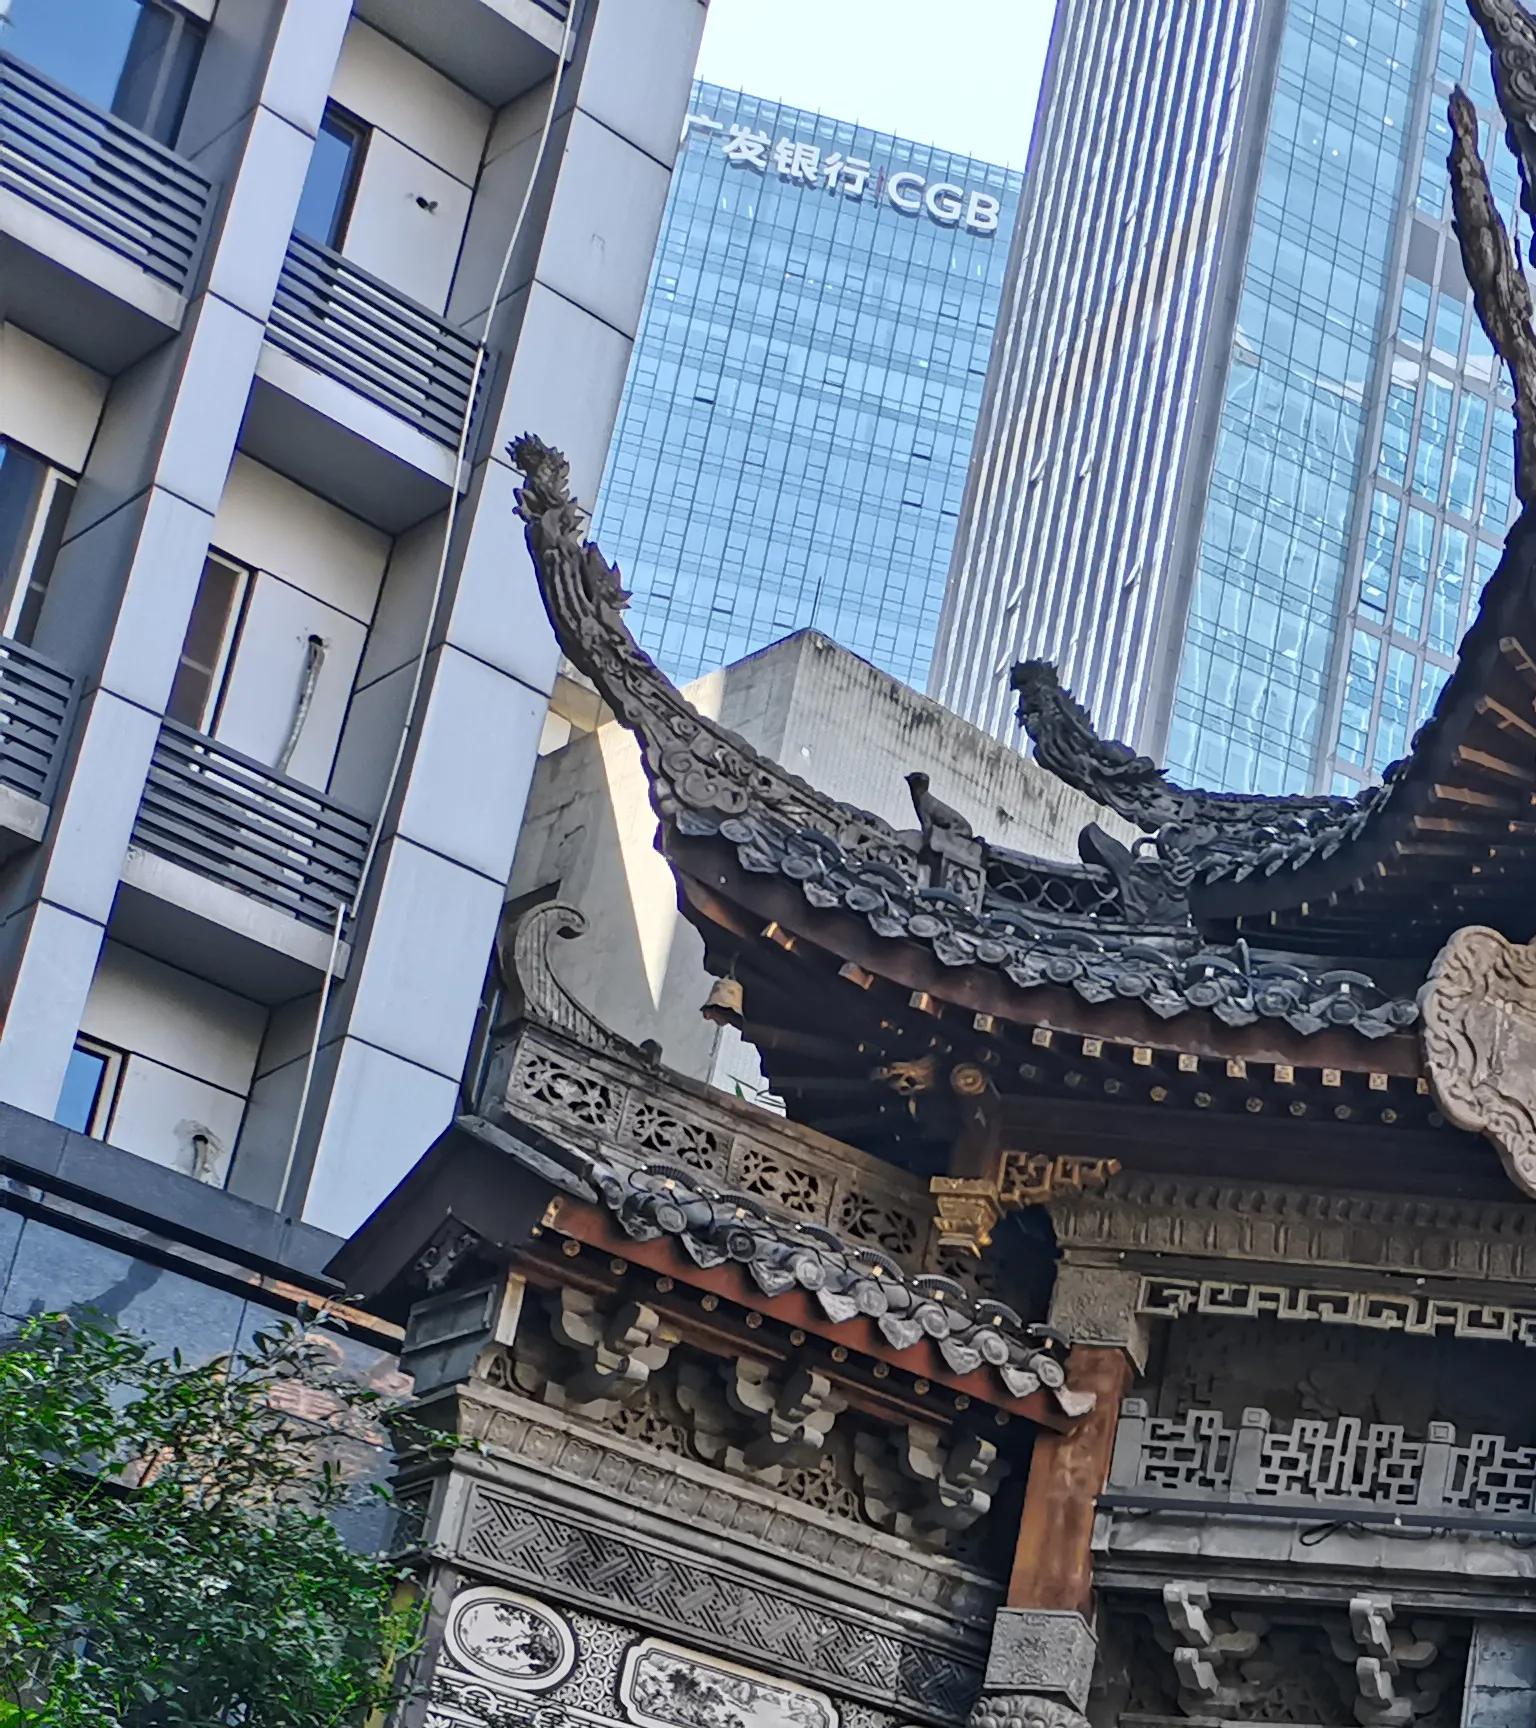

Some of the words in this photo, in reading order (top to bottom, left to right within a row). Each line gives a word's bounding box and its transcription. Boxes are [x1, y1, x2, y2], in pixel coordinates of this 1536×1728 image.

[680, 113, 871, 194] 广发银行
[887, 172, 1000, 232] CGB
